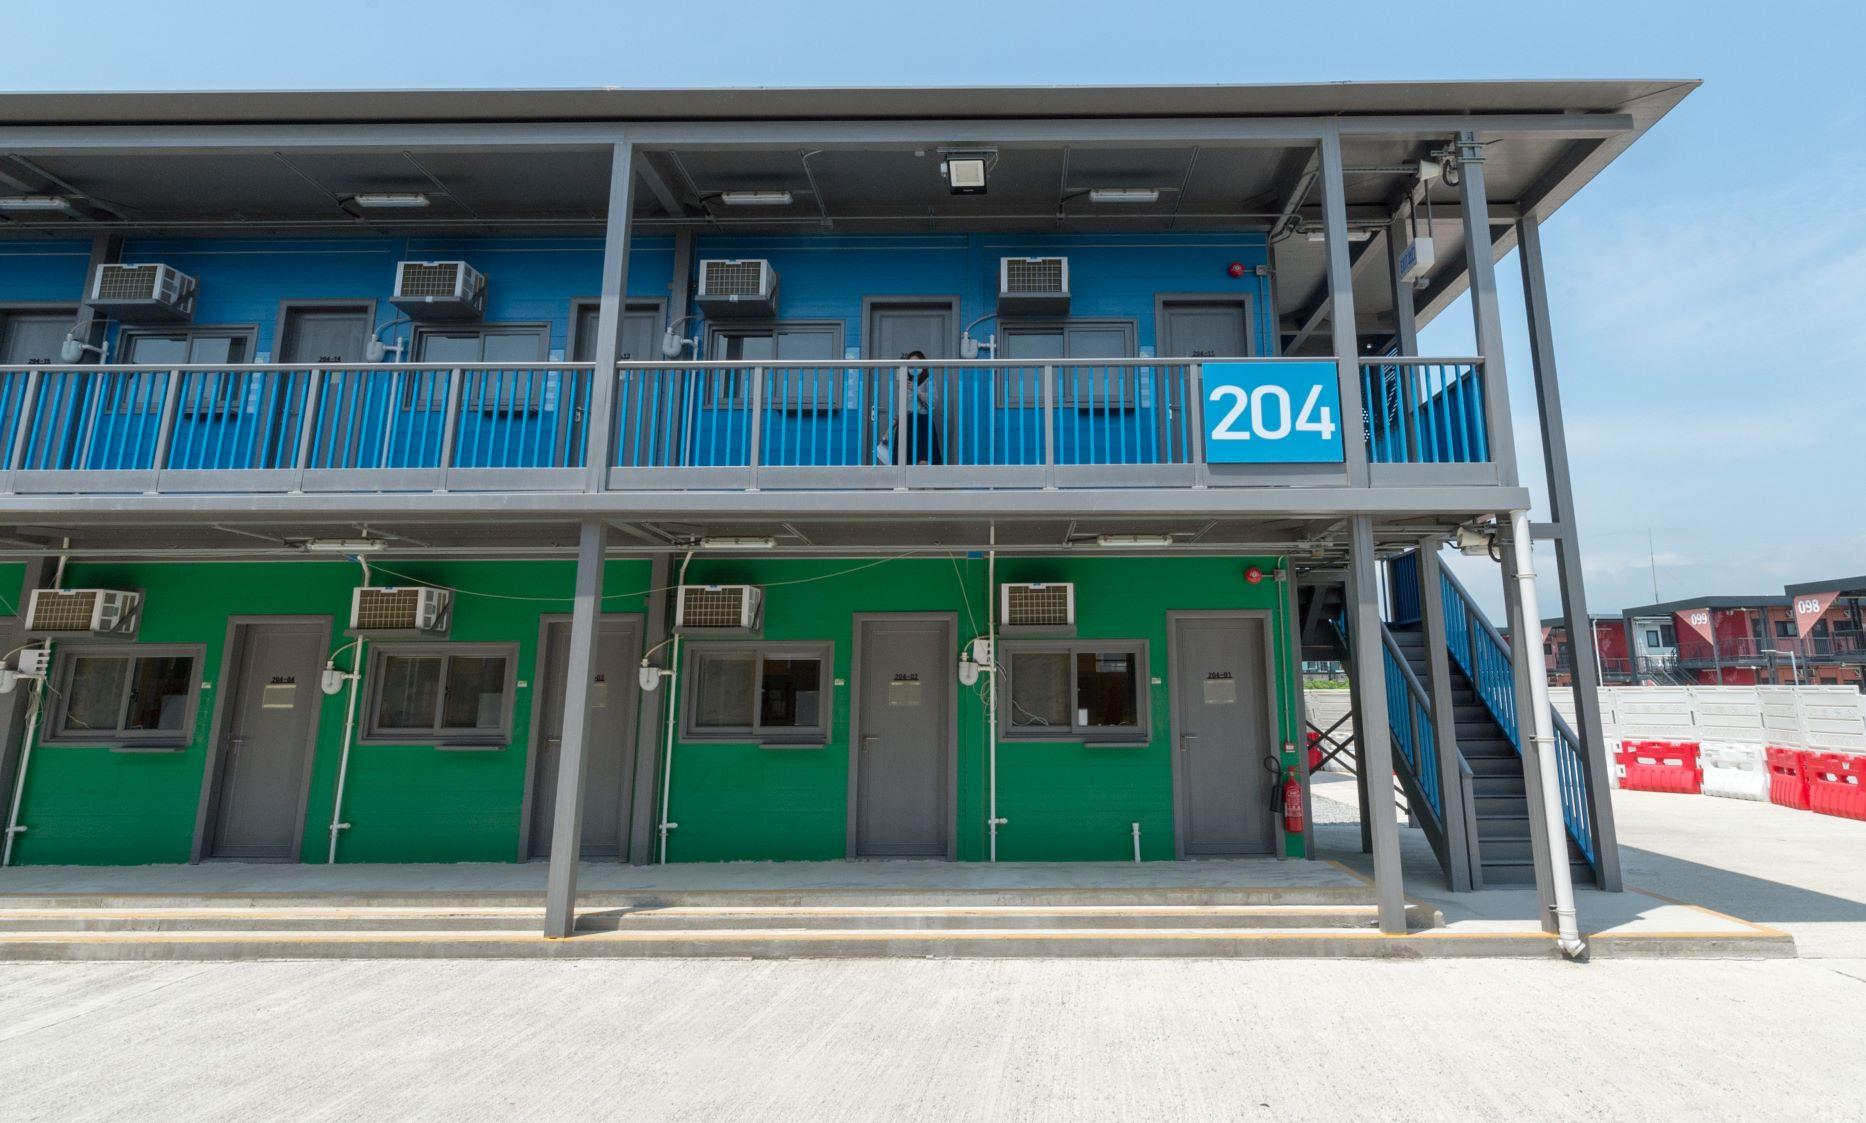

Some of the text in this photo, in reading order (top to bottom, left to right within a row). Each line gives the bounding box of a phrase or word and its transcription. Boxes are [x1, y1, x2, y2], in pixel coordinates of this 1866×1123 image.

[1209, 384, 1336, 440] 204
[1798, 599, 1820, 614] 098
[1691, 613, 1708, 625] 099
[894, 673, 919, 681] 204-02
[1207, 671, 1233, 680] 204-01
